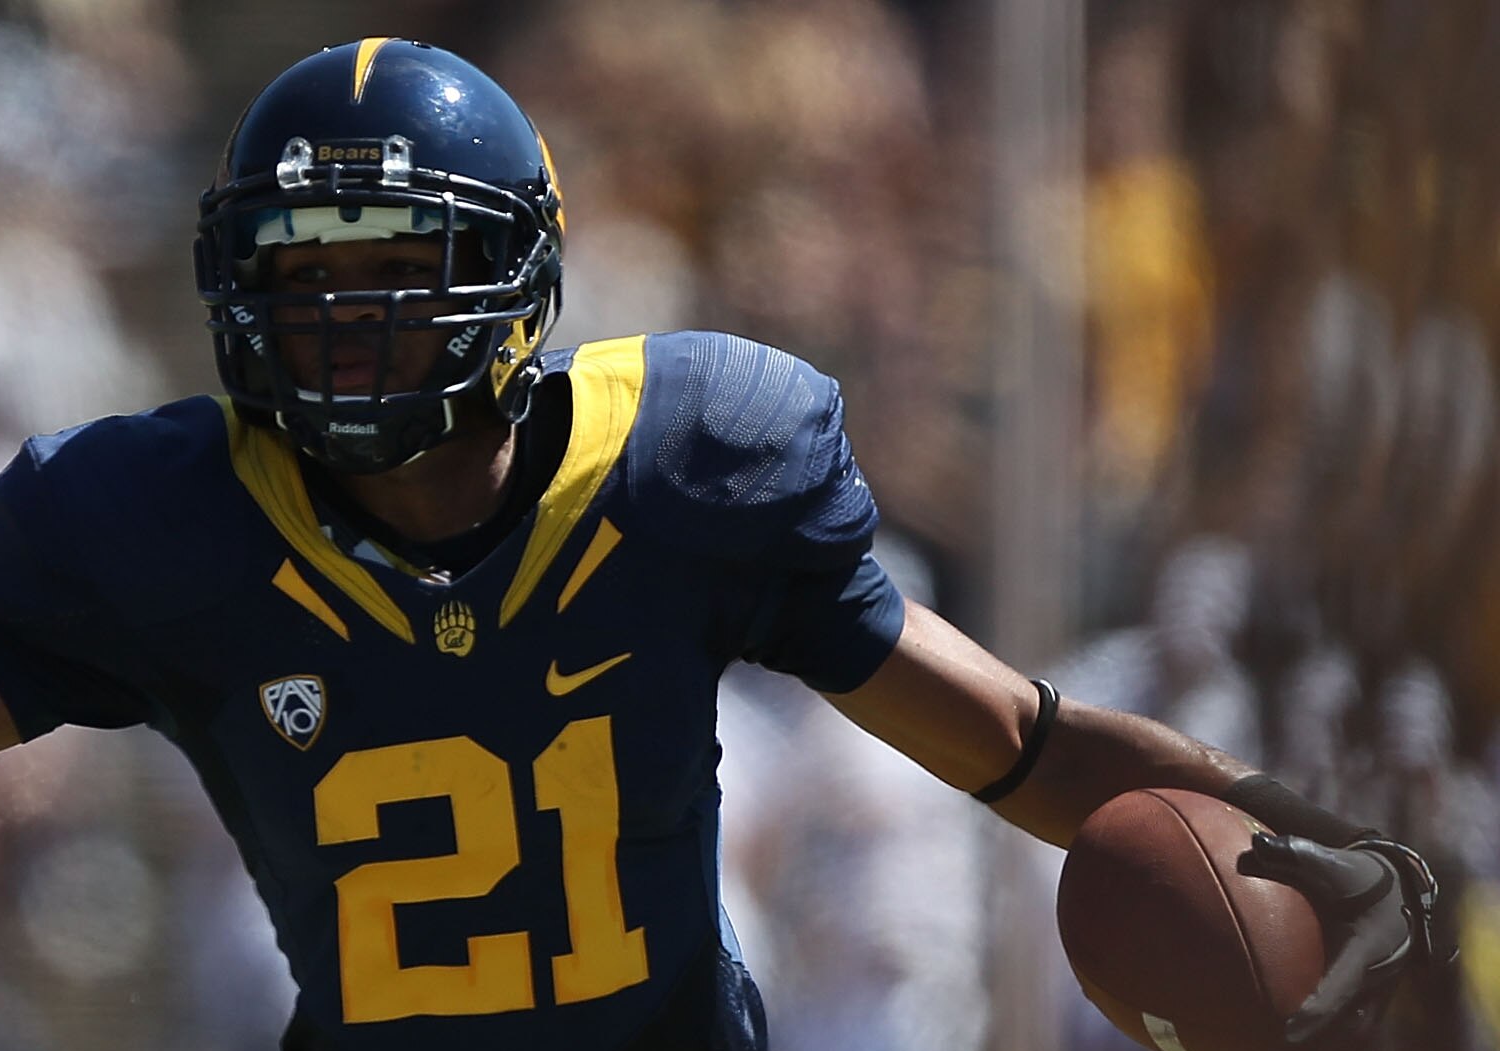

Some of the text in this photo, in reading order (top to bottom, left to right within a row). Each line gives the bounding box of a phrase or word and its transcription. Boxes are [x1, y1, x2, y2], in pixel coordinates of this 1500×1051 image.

[318, 146, 380, 160] Bears
[328, 422, 375, 434] Riddell
[443, 630, 466, 650] Cal
[263, 679, 321, 722] PAC
[282, 708, 317, 736] 10
[314, 715, 650, 1024] 21
